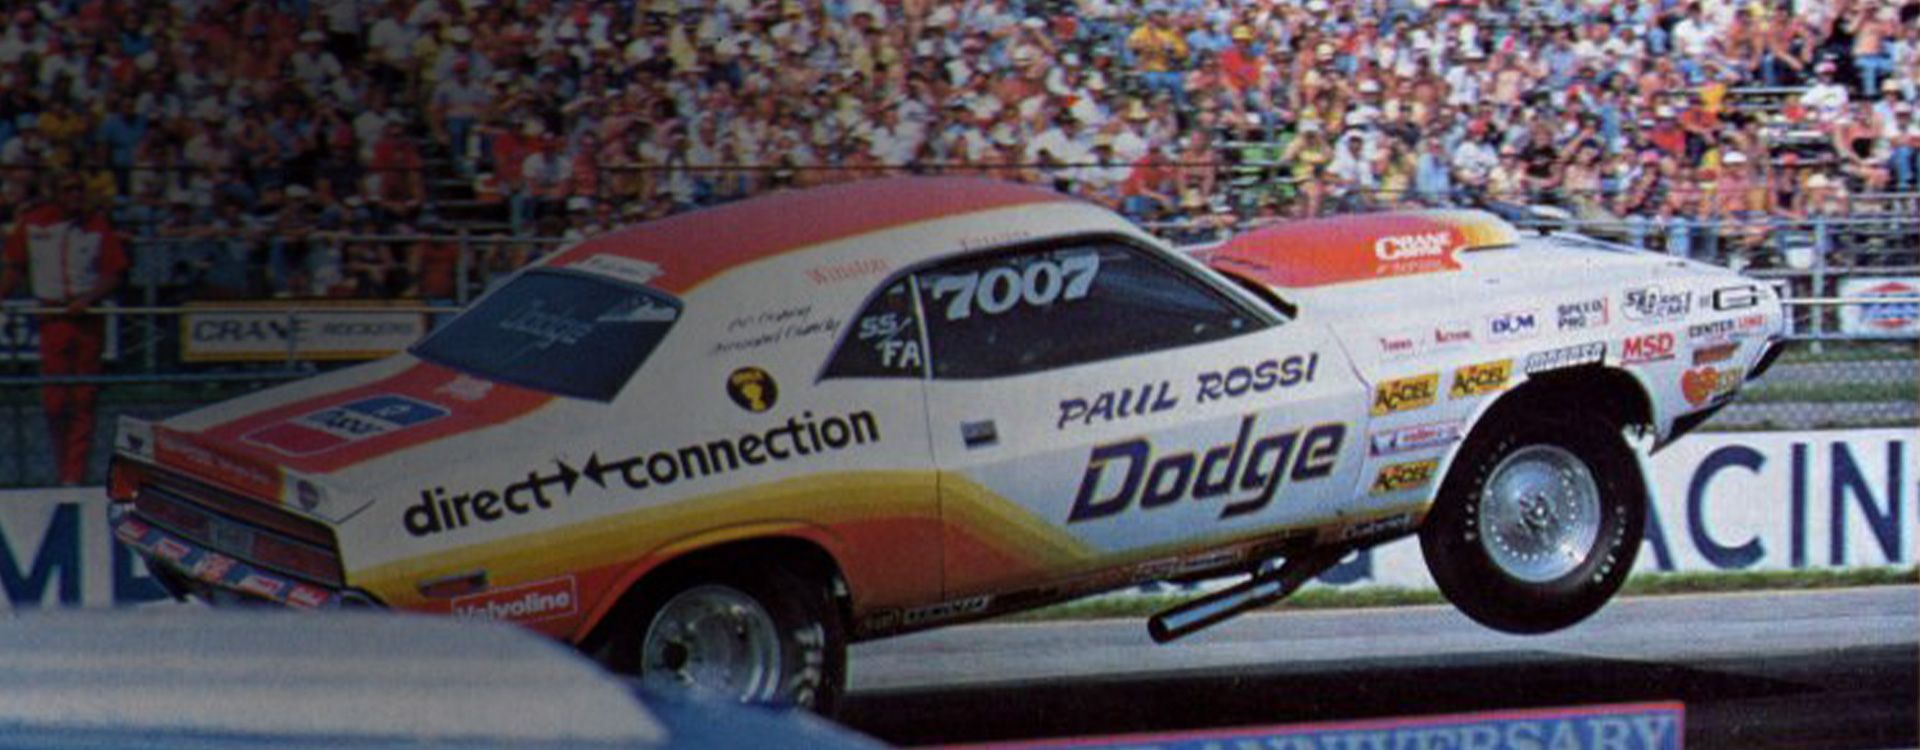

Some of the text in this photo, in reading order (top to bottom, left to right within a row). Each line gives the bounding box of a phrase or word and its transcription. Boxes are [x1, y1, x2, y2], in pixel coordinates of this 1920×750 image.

[932, 250, 1099, 320] 7007
[1621, 332, 1675, 360] MSD
[1688, 318, 1735, 338] CENTER
[876, 339, 922, 369] FA
[1057, 352, 1319, 430] PAUL ROSSI
[403, 410, 880, 537] direct connection
[1067, 412, 1348, 524] Dodge
[455, 590, 571, 622] Valvoline
